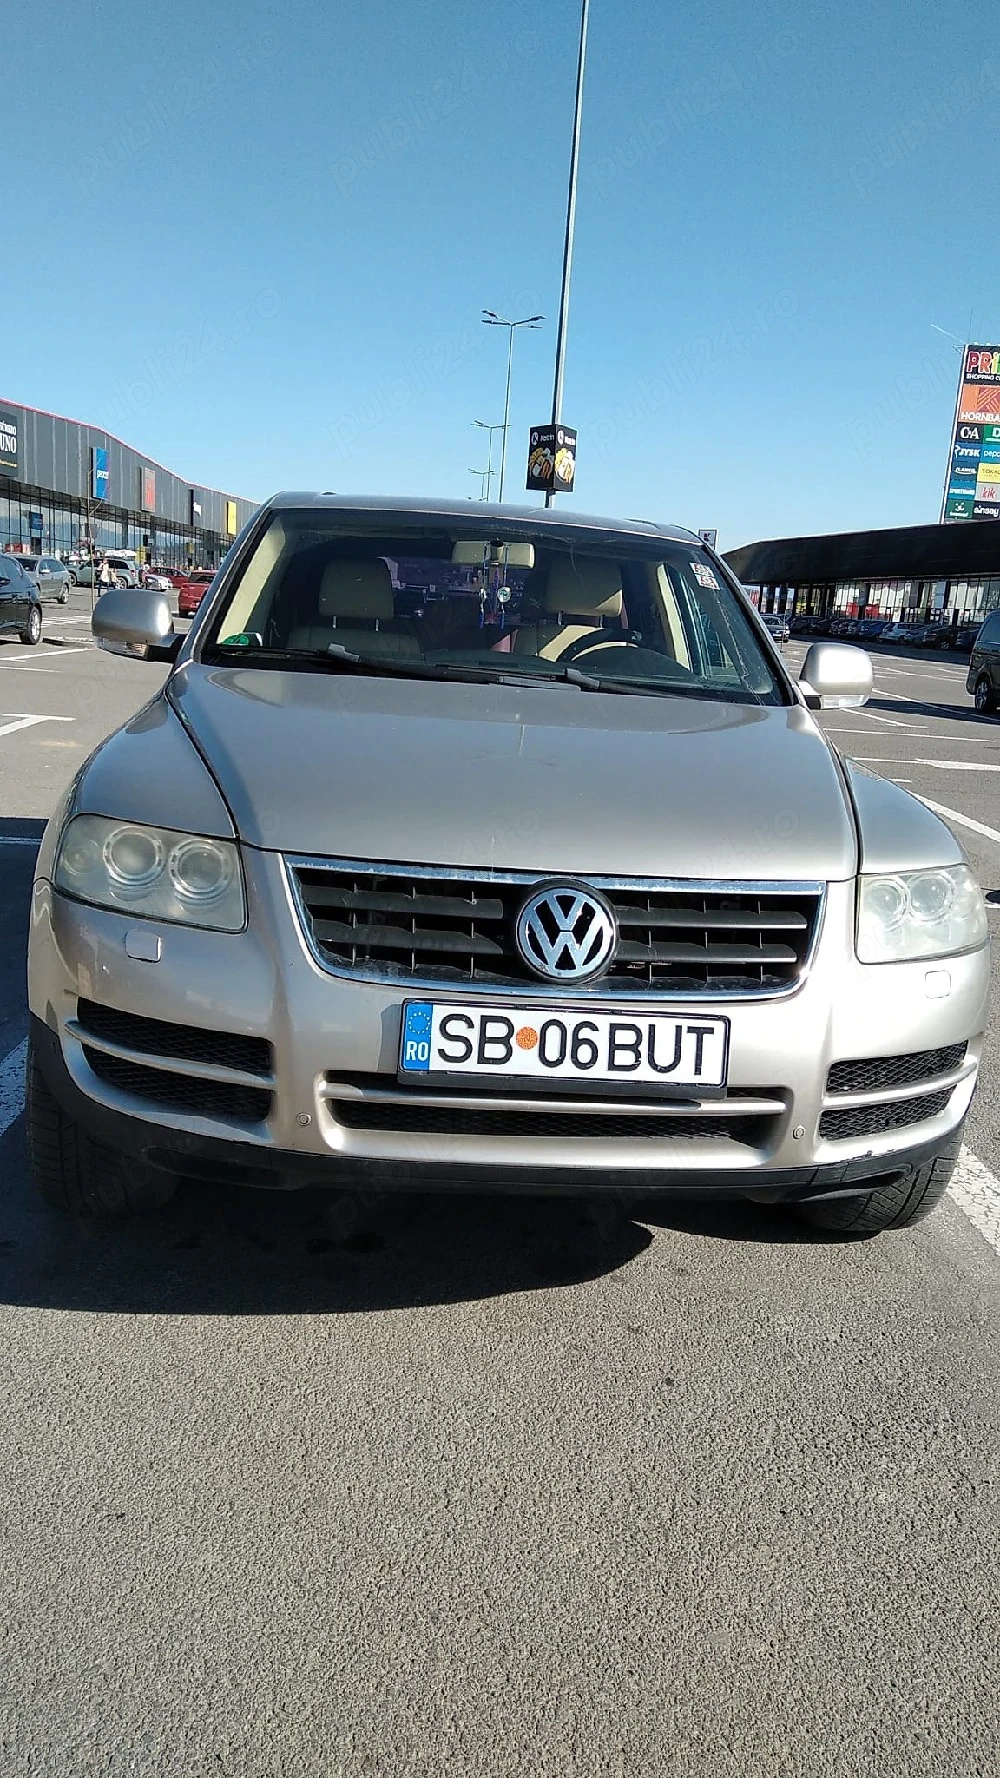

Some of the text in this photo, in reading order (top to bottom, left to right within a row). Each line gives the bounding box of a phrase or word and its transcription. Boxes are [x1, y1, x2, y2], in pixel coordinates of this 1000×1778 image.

[0, 433, 17, 454] UNO
[959, 446, 981, 457] JYSK
[438, 1013, 515, 1065] SB
[405, 1040, 428, 1063] RO
